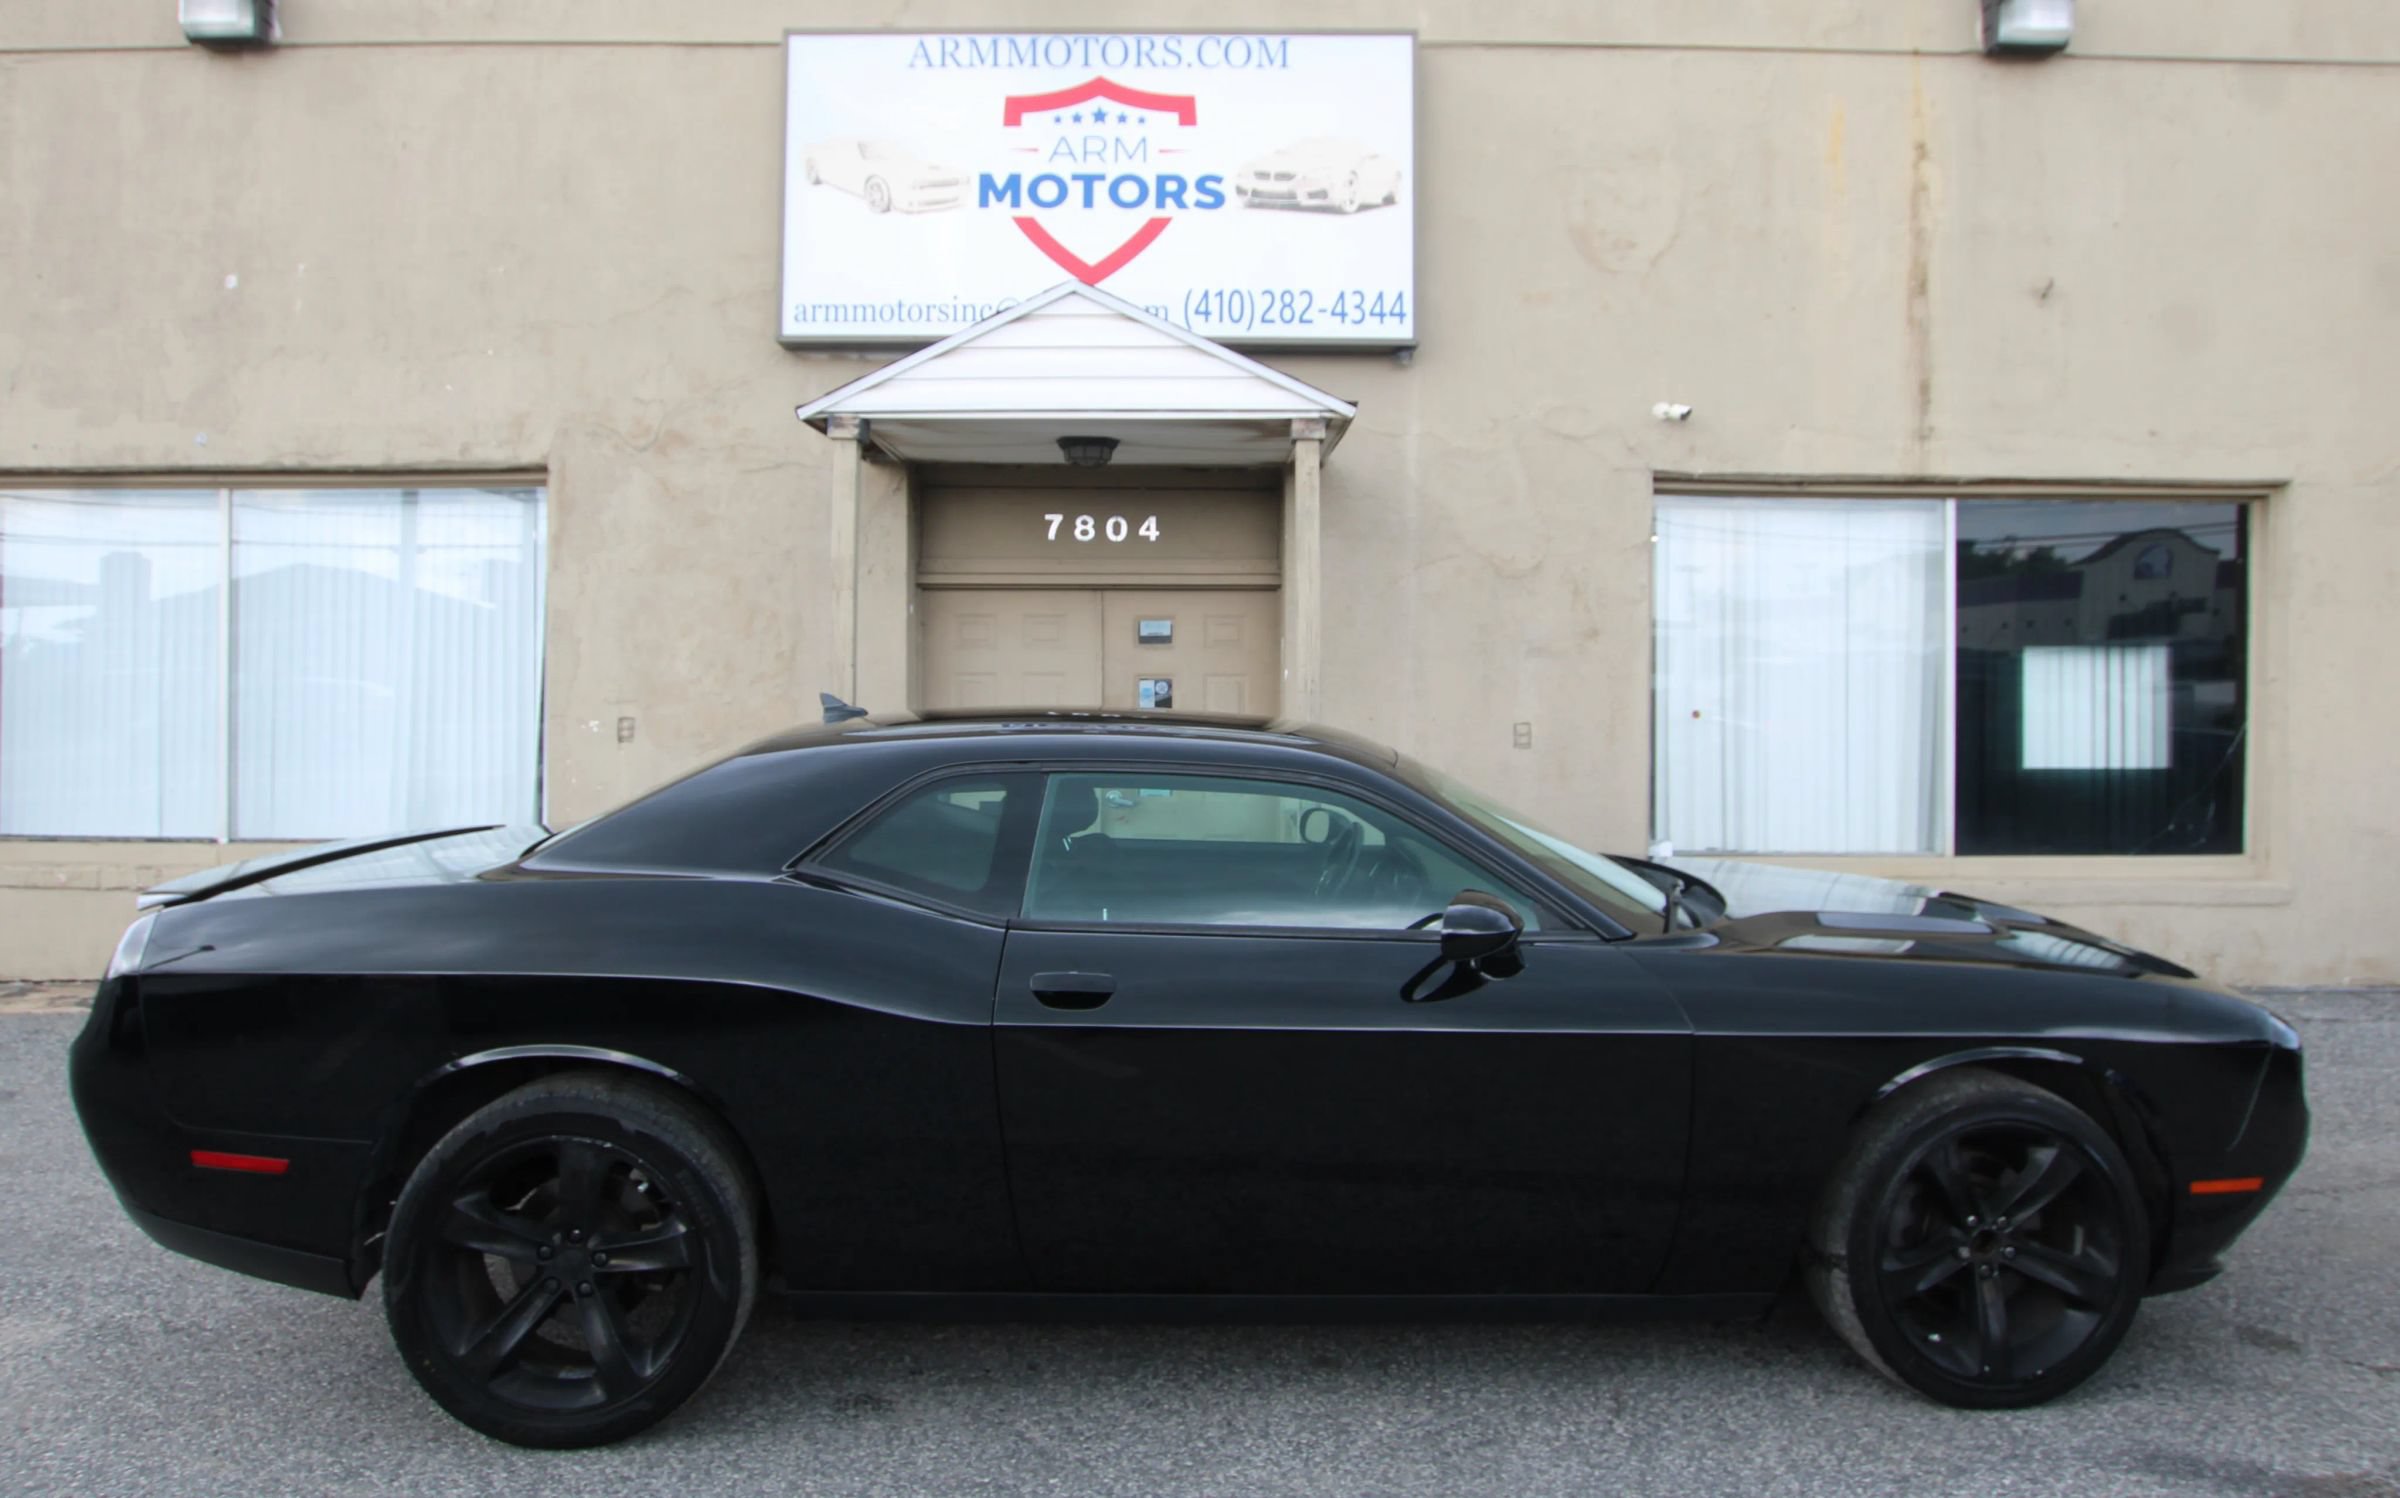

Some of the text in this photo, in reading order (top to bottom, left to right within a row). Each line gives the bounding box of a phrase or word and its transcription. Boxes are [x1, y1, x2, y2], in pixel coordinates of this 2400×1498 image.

[908, 35, 1291, 69] ARMMOTORS.COM
[1048, 135, 1147, 163] ARM
[978, 173, 1226, 210] MOTORS
[1184, 288, 1407, 332] (410)282-4344
[1044, 513, 1160, 542] 7804
